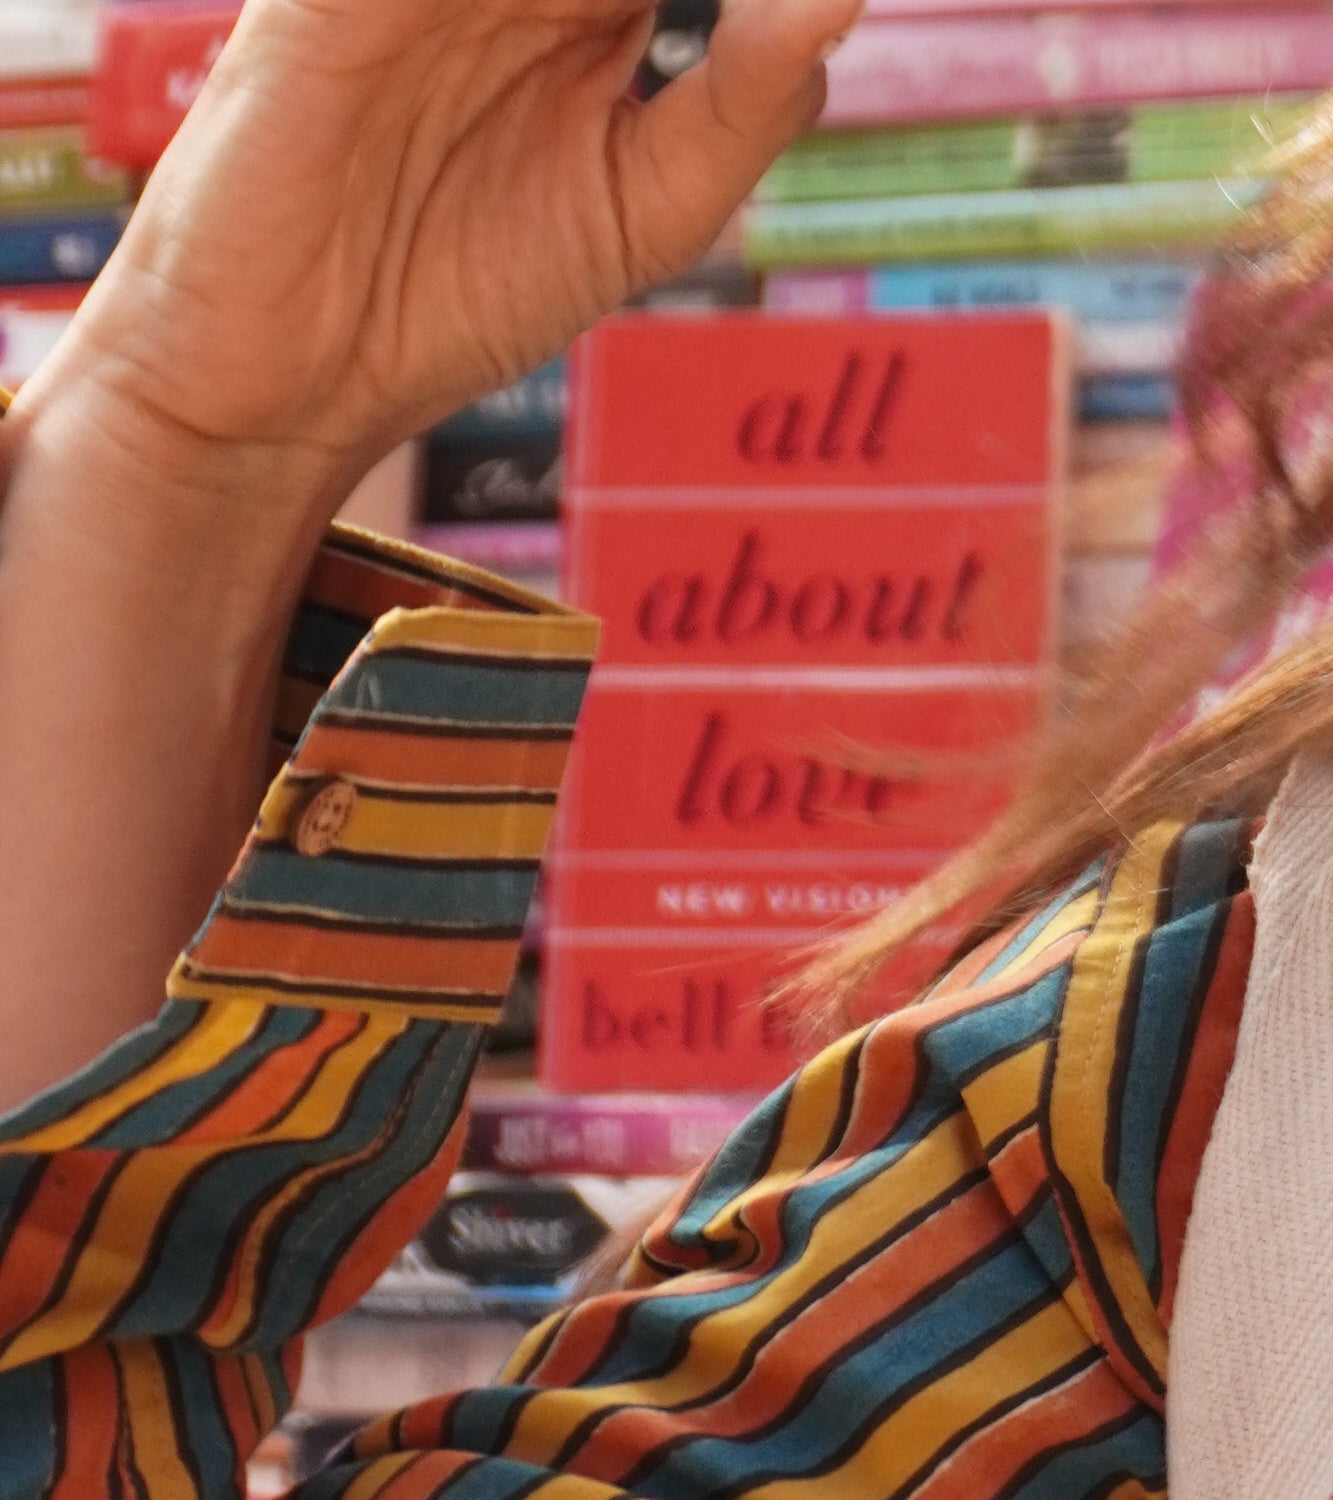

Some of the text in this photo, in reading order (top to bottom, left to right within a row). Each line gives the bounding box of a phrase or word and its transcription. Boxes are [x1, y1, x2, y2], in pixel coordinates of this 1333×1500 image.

[736, 348, 905, 464] all
[634, 527, 984, 645] about
[675, 710, 920, 828] love
[656, 881, 748, 914] NEW
[579, 975, 732, 1053] bell
[447, 1200, 574, 1258] Shiver
